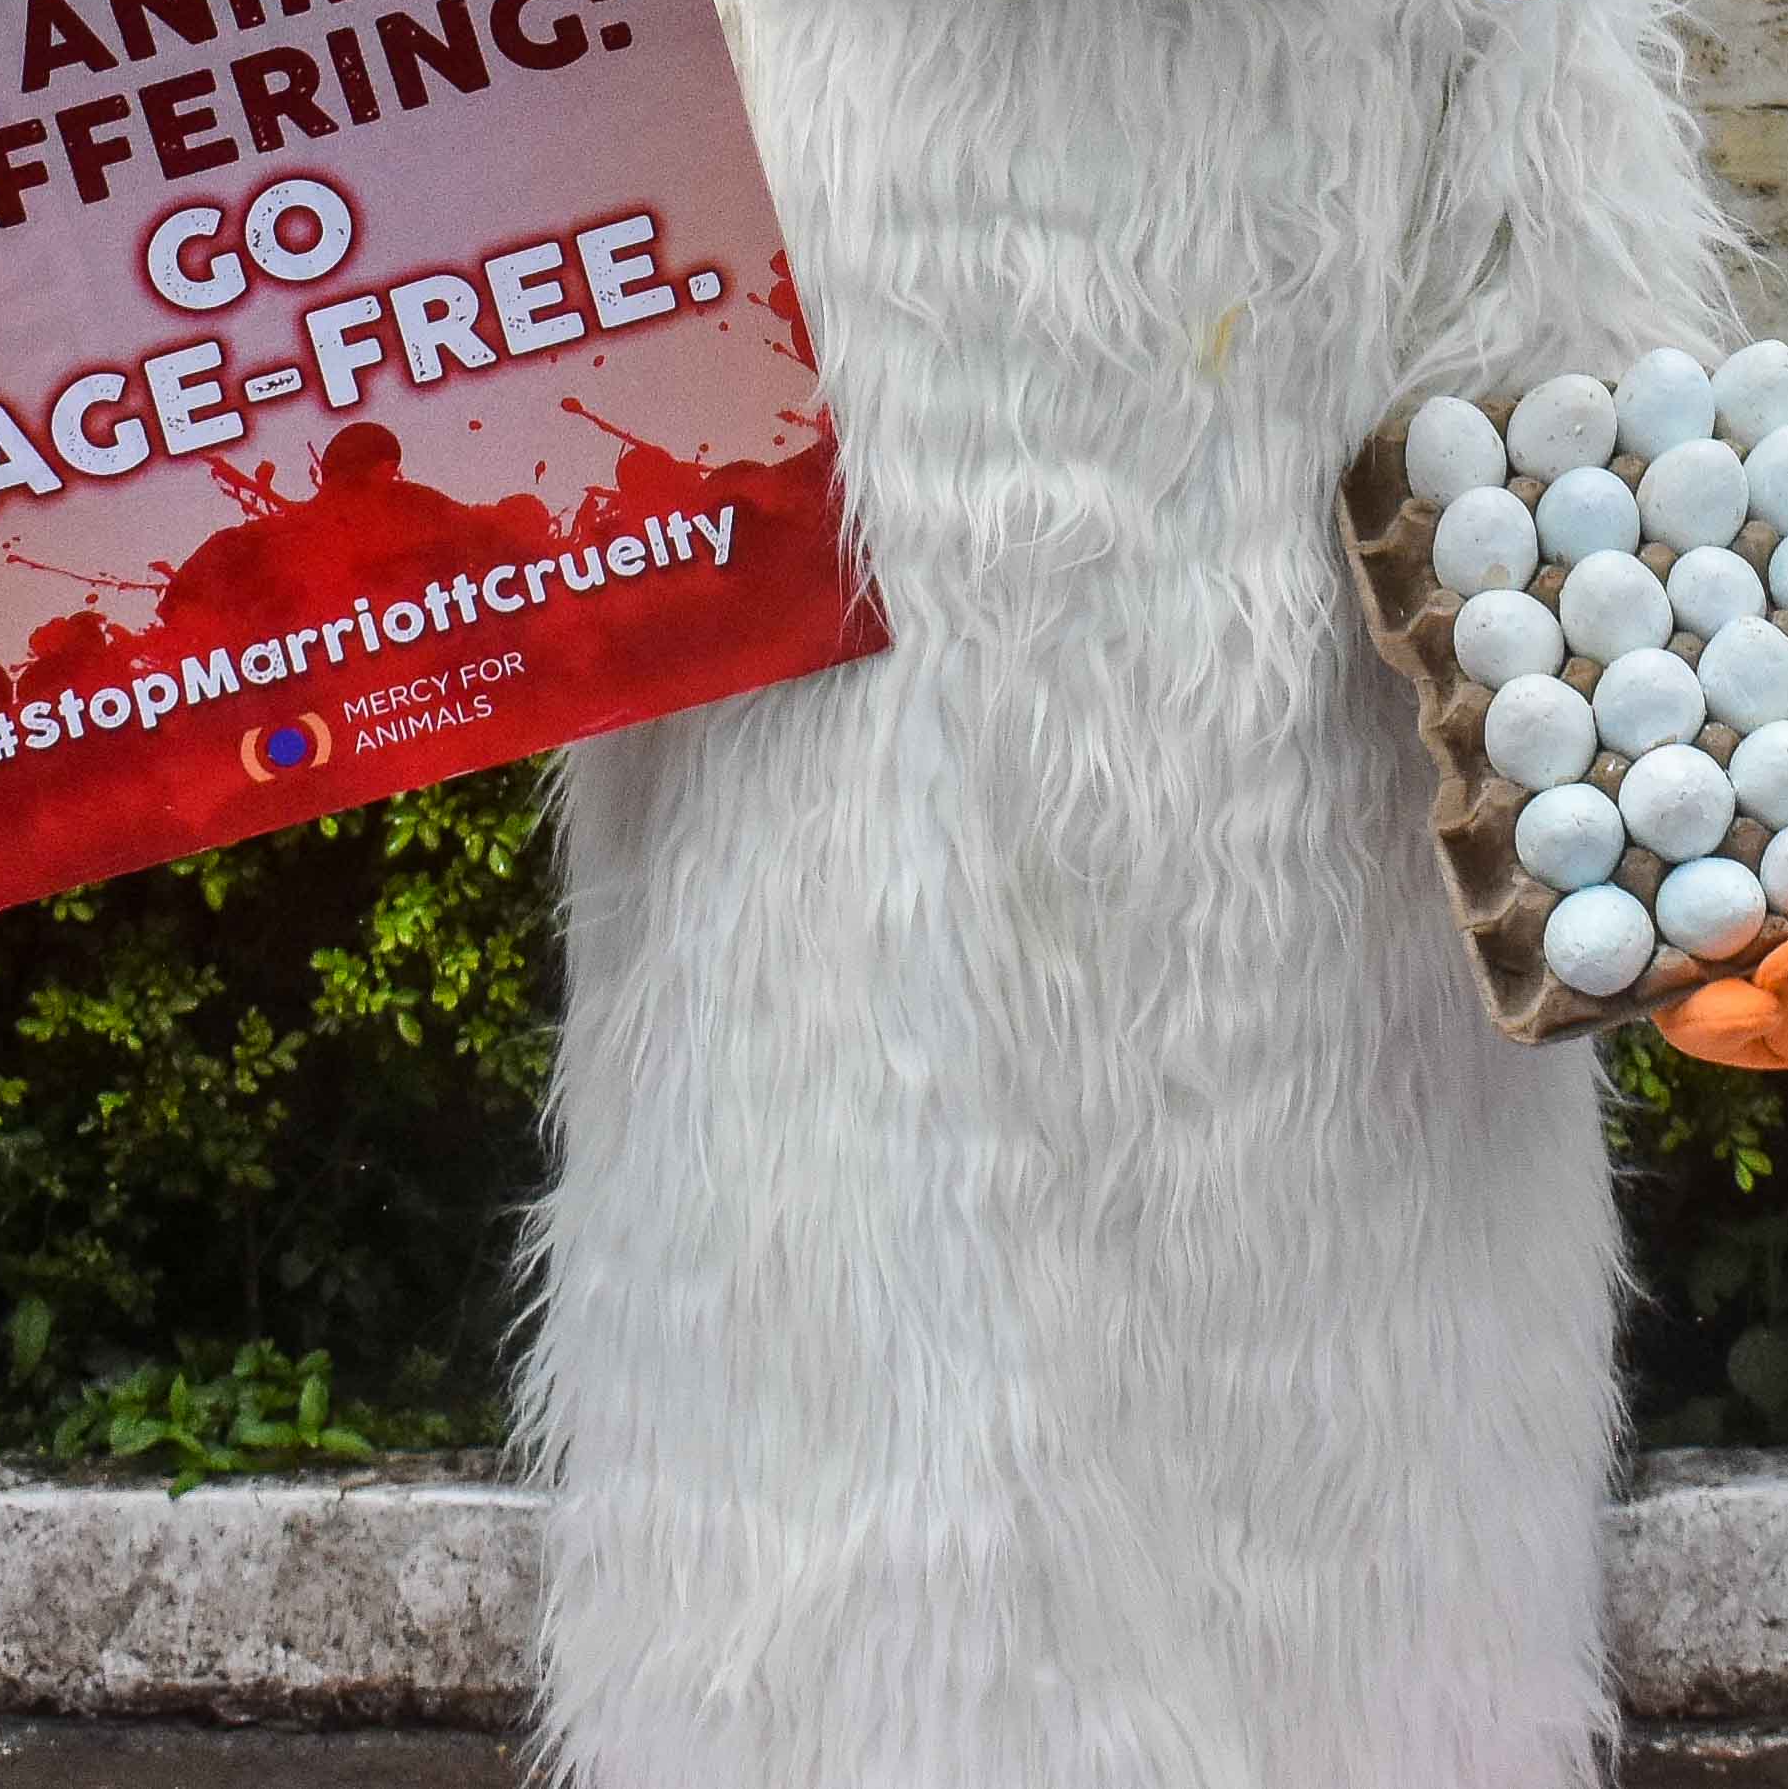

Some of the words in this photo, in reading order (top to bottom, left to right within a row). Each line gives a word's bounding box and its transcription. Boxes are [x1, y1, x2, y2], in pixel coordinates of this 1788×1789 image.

[147, 178, 353, 310] GO
[343, 671, 450, 723] MERCY
[460, 651, 525, 689] FOR
[355, 695, 493, 754] ANIMALS
